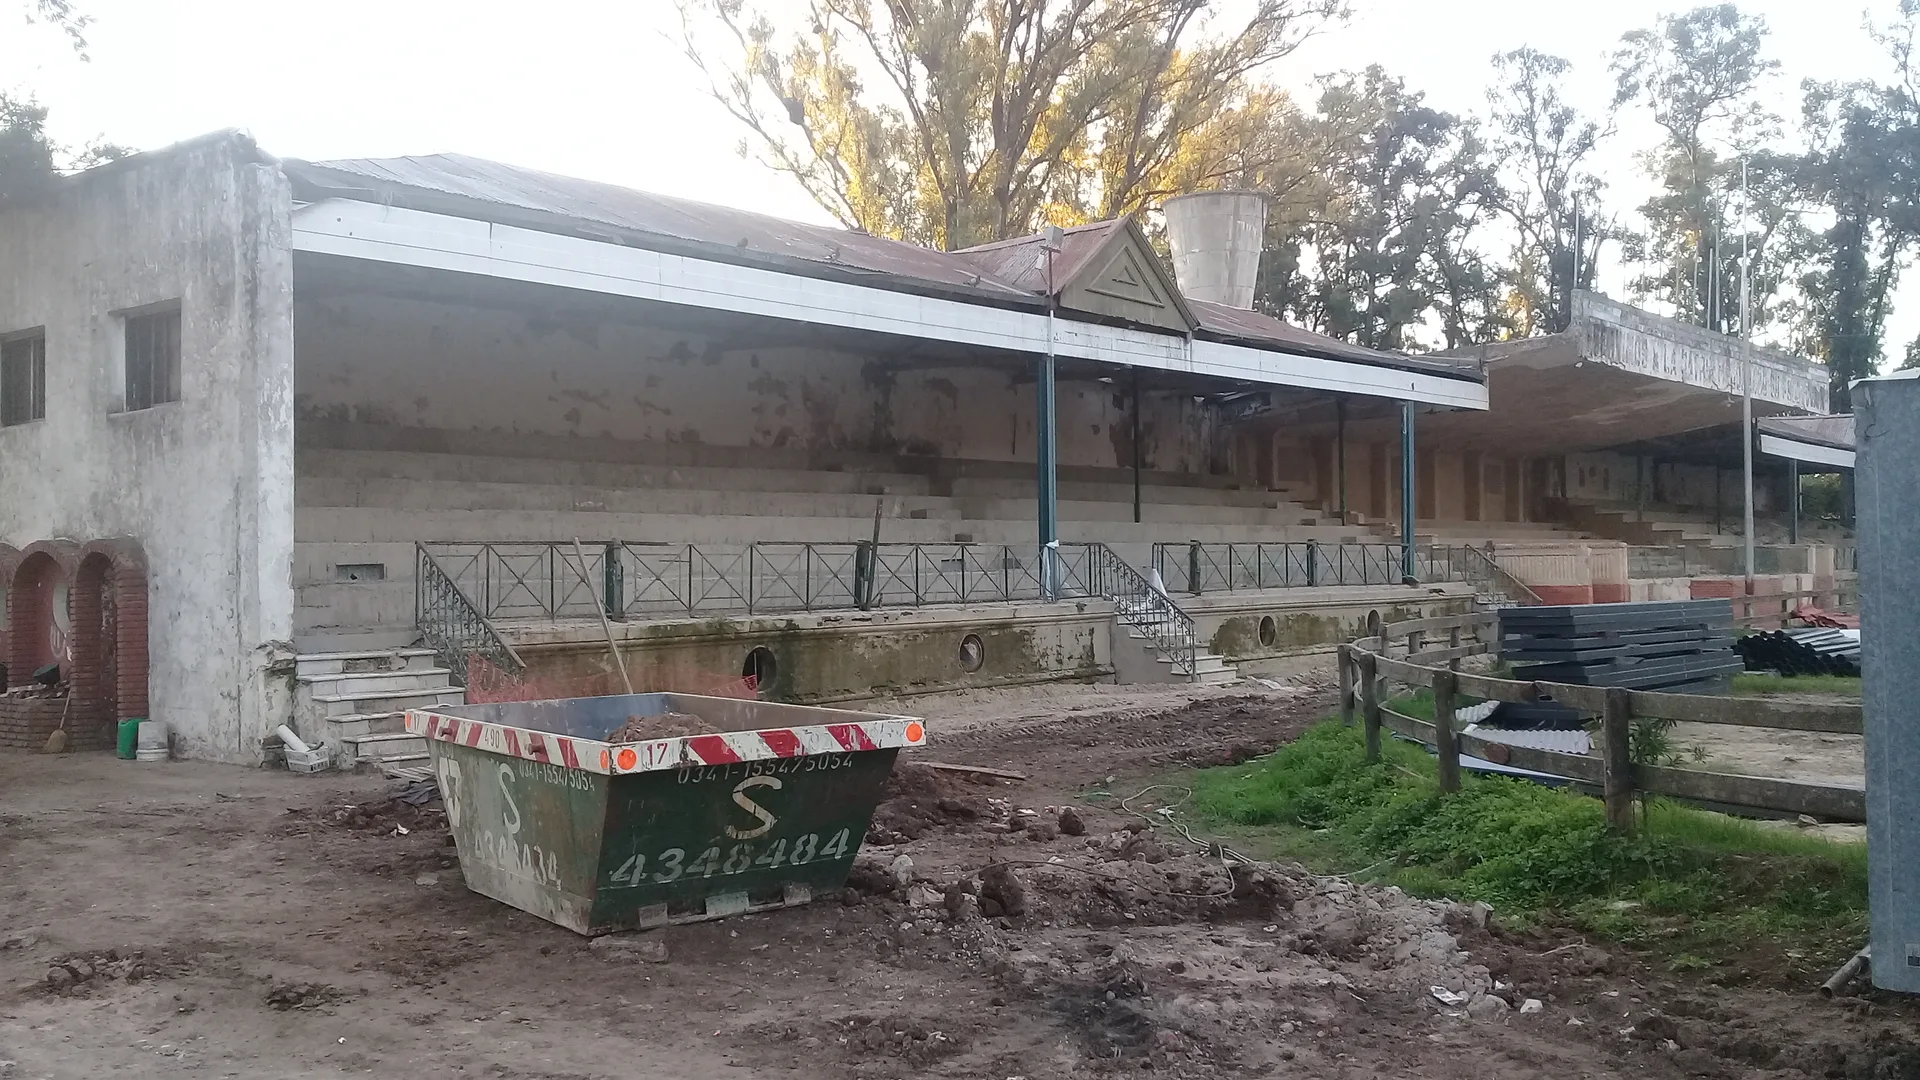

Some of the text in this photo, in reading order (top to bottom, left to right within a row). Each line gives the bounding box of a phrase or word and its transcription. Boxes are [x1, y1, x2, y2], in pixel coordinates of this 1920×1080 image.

[484, 727, 501, 749] 490
[646, 742, 668, 767] 17
[723, 775, 783, 840] S
[608, 827, 851, 888] 4348484
